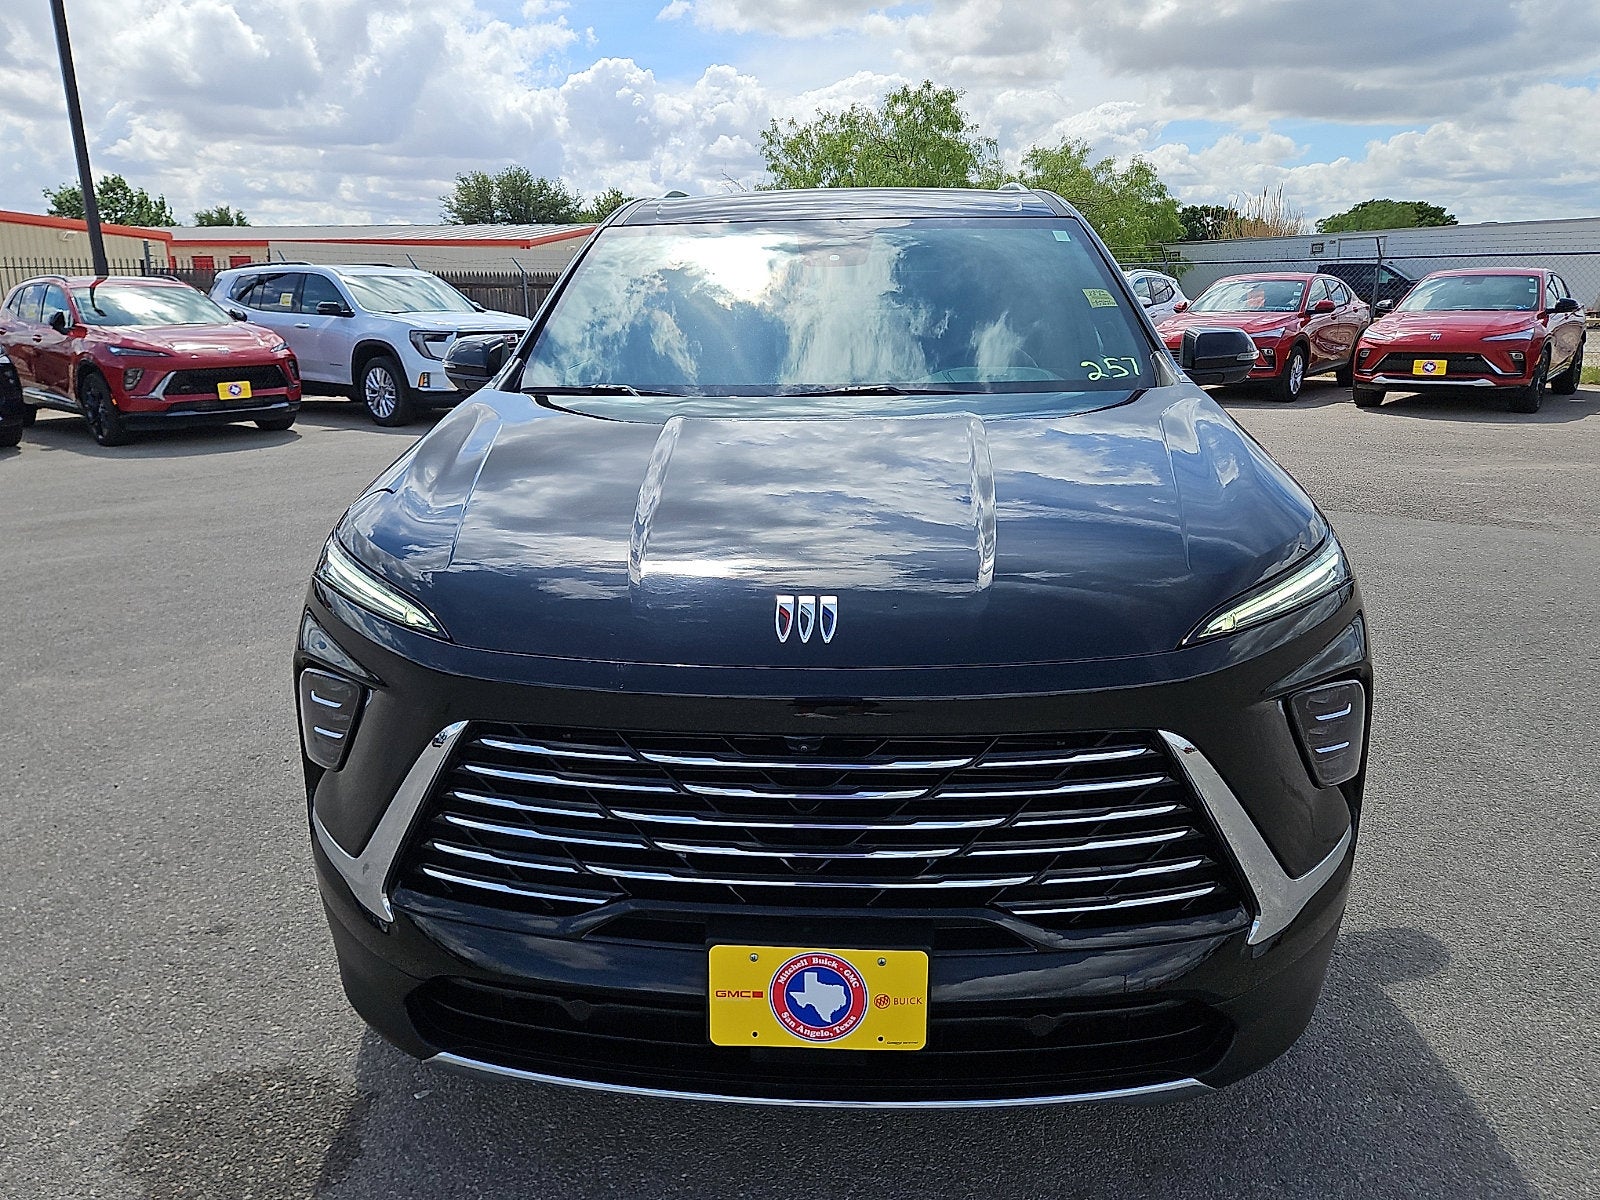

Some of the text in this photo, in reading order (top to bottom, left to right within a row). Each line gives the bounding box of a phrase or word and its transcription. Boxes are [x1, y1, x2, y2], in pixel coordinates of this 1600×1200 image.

[1080, 357, 1140, 381] 257
[777, 959, 809, 985] Mitchell
[812, 956, 839, 970] Buick
[843, 968, 860, 989] GMC
[715, 990, 752, 998] GMC
[893, 996, 923, 1006] BUICK
[781, 1010, 857, 1038] San Angelo, Texas
